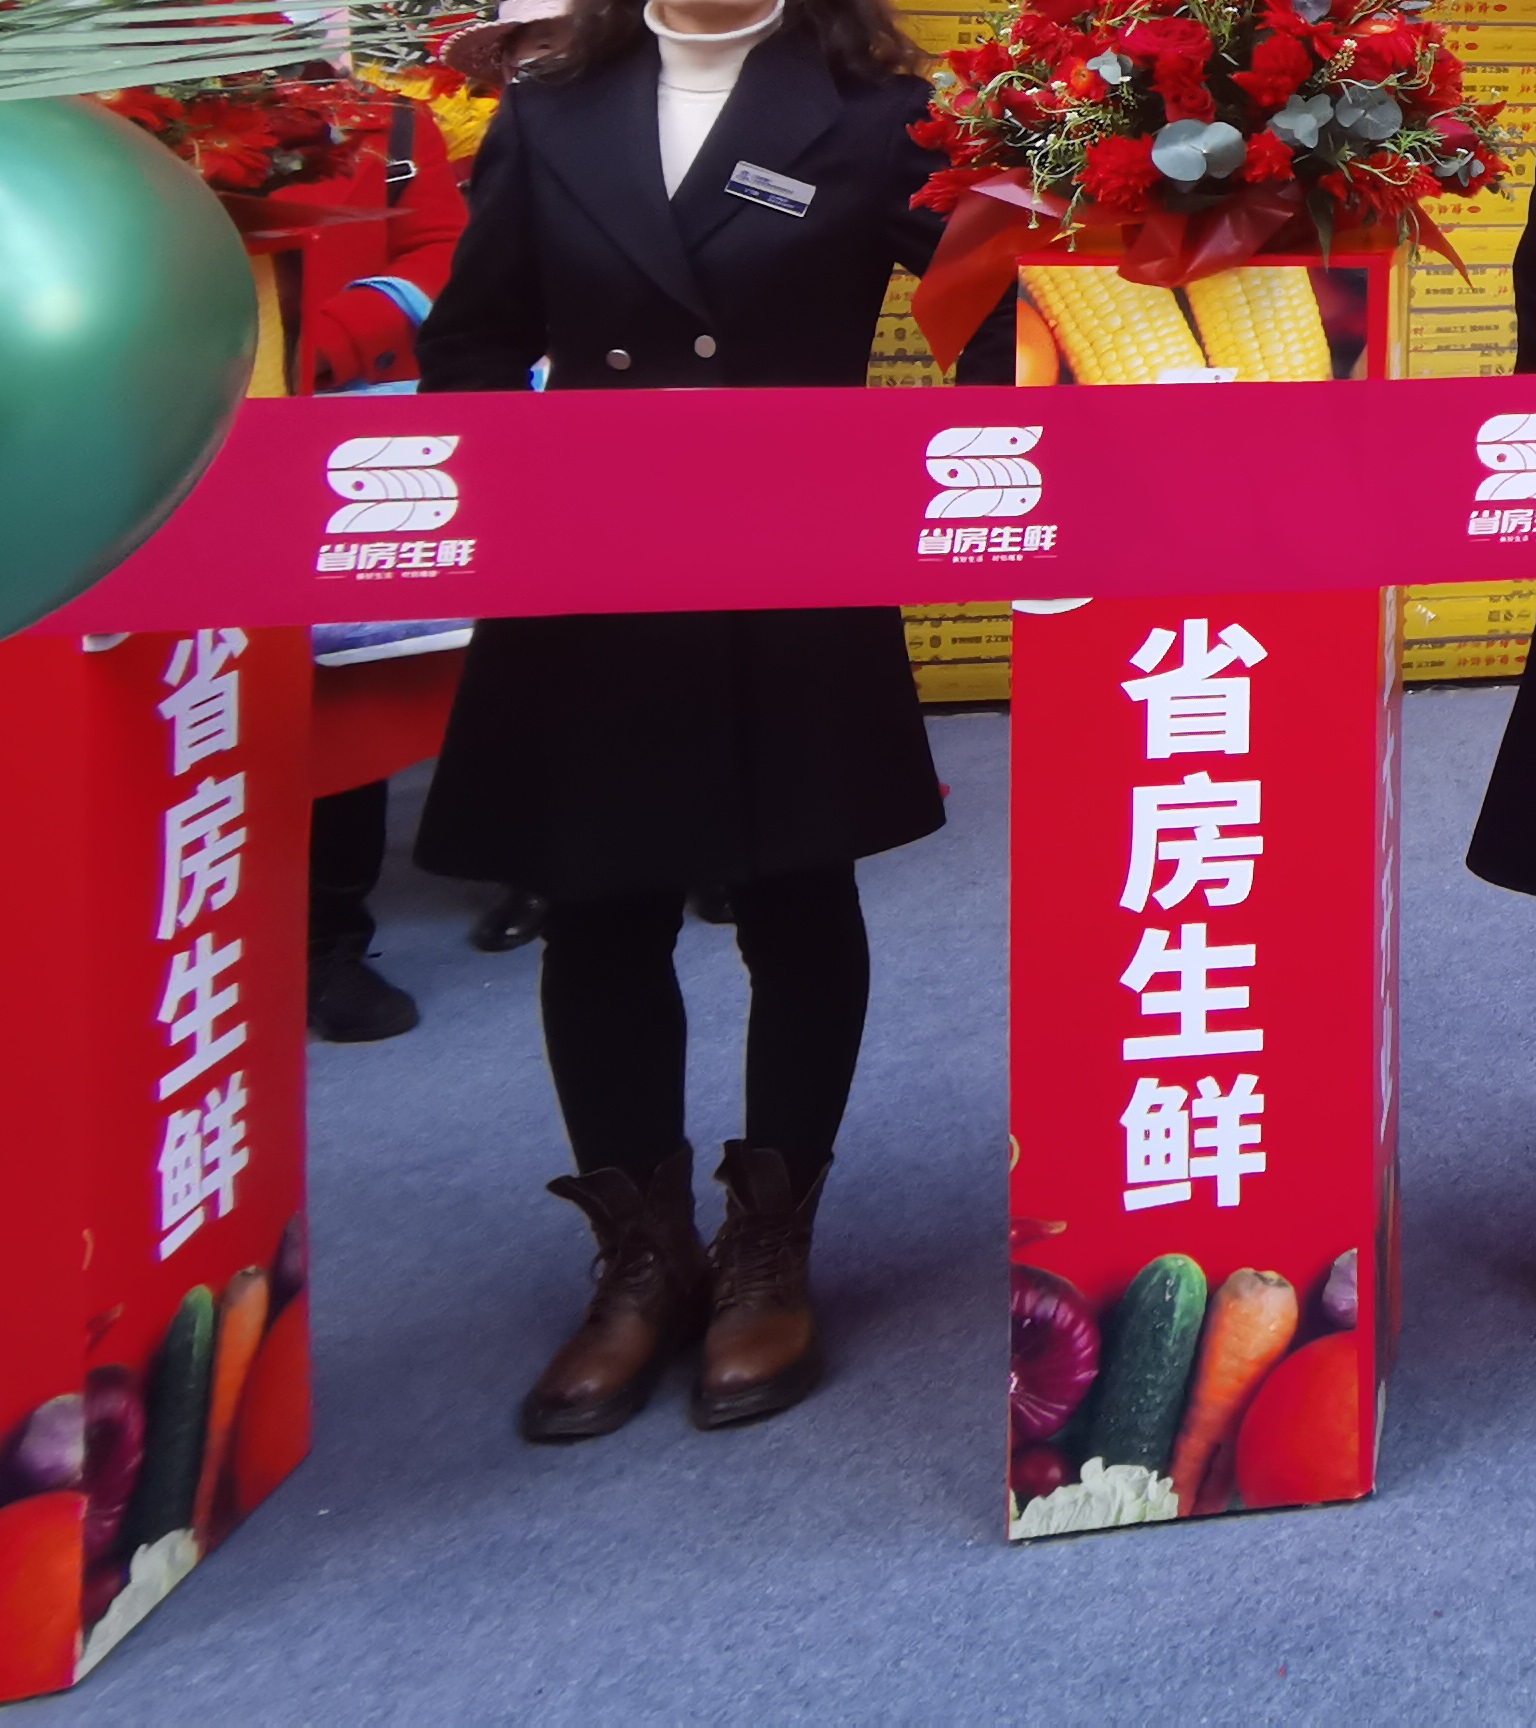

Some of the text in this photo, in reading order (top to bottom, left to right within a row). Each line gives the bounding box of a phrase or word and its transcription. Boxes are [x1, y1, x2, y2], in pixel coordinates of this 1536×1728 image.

[317, 540, 476, 571] 省房生鲜
[918, 525, 1058, 556] 省房生鲜
[158, 628, 249, 1259] 省房生鲜
[1120, 618, 1268, 1211] 省房生鲜
